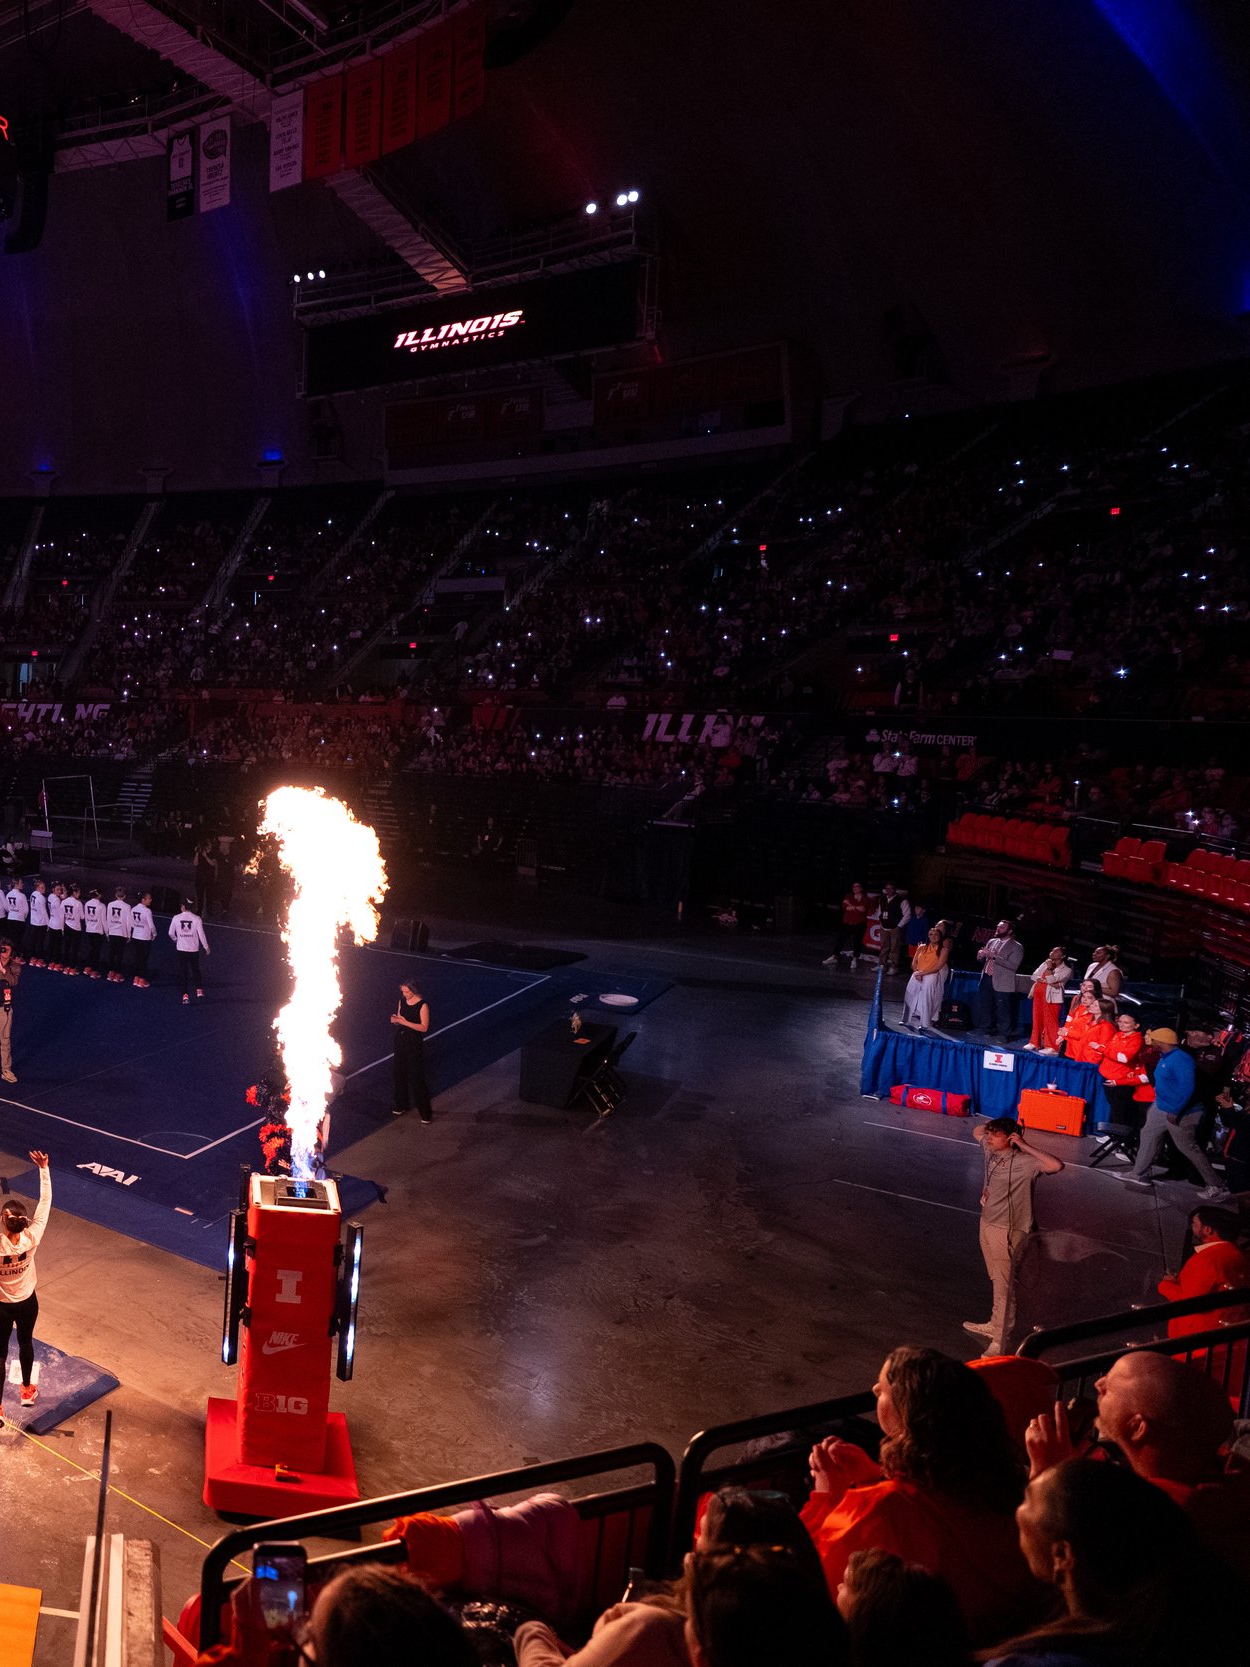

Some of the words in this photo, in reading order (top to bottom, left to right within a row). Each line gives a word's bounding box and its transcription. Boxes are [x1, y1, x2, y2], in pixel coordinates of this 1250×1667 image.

[393, 309, 524, 349] ILLINOIS
[409, 329, 505, 353] GYMNASTICS
[275, 1269, 303, 1305] I
[268, 1330, 300, 1346] NIKE
